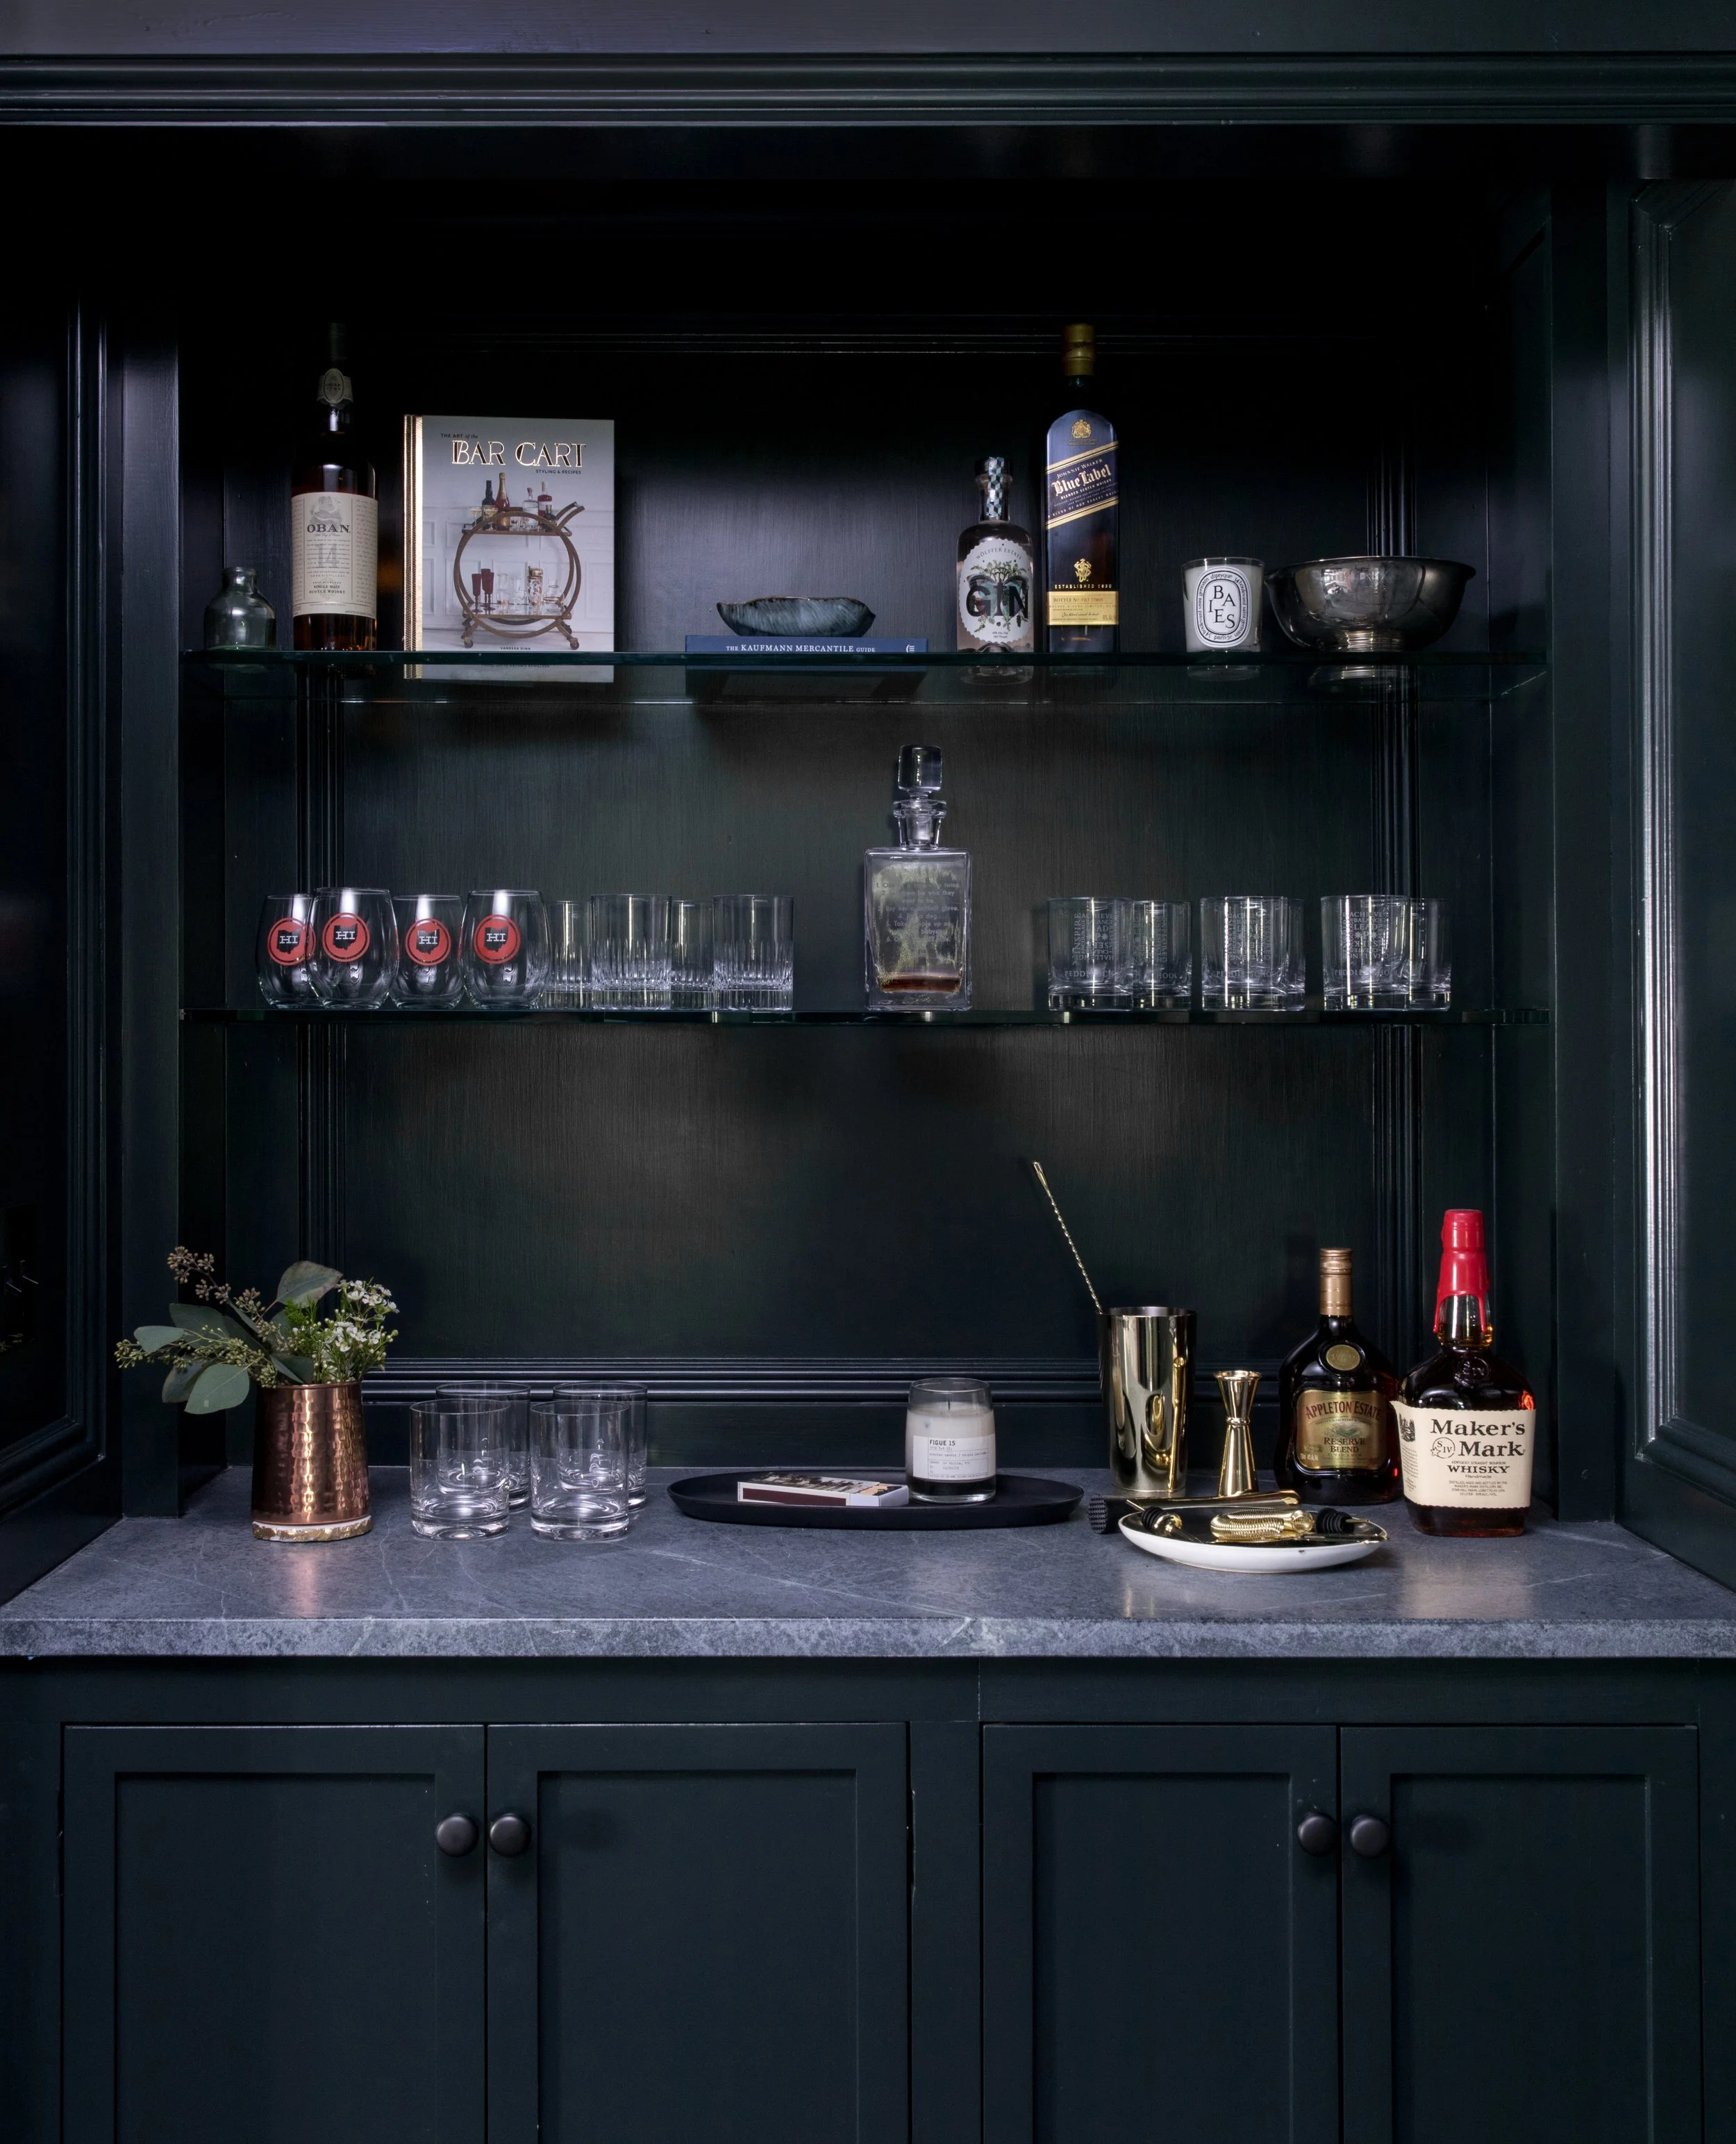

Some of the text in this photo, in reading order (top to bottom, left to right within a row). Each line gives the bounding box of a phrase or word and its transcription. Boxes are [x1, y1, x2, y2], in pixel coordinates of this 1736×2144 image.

[451, 440, 587, 467] BAR CART
[1056, 458, 1103, 480] JOHNNIE WALKER
[1051, 464, 1112, 497] Blue Label
[966, 585, 1028, 618] GIN
[279, 935, 298, 944] HI
[335, 931, 356, 940] HI
[419, 936, 438, 945] HI
[486, 933, 506, 942] HI
[1305, 1401, 1383, 1420] APPLETON ESTATE
[1430, 1418, 1526, 1436] Maker's
[1324, 1437, 1366, 1445] RESERVE
[1458, 1440, 1525, 1457] Mark
[1446, 1465, 1510, 1474] WHISKY
